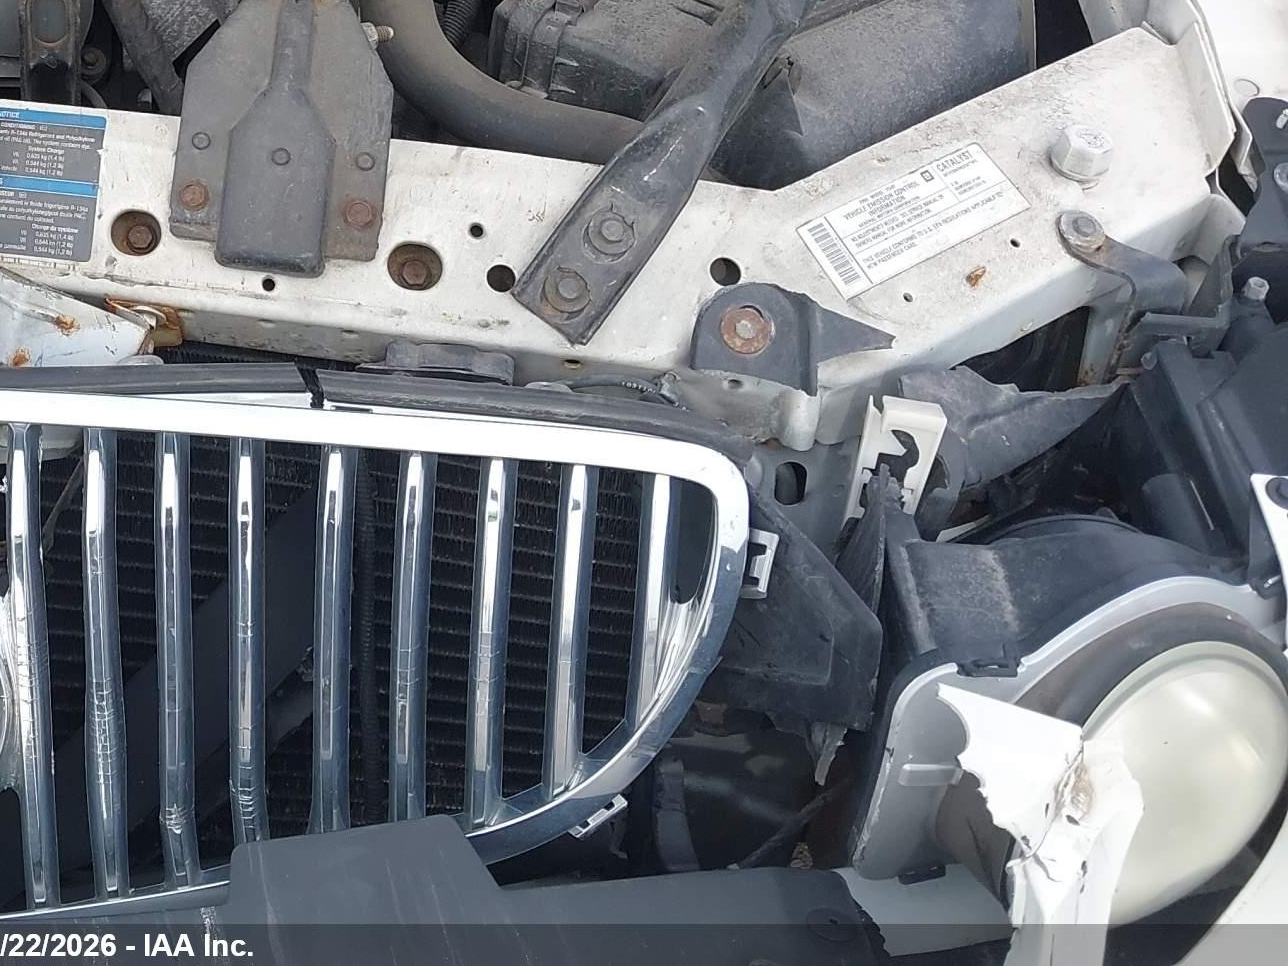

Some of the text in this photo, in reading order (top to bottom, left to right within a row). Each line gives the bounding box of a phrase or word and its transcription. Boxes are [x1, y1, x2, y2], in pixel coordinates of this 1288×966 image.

[27, 145, 65, 155] System Charge
[935, 150, 973, 172] CATALYST
[866, 192, 894, 209] EMISSION
[893, 180, 920, 196] CONTROL
[867, 195, 906, 216] INFORMATION
